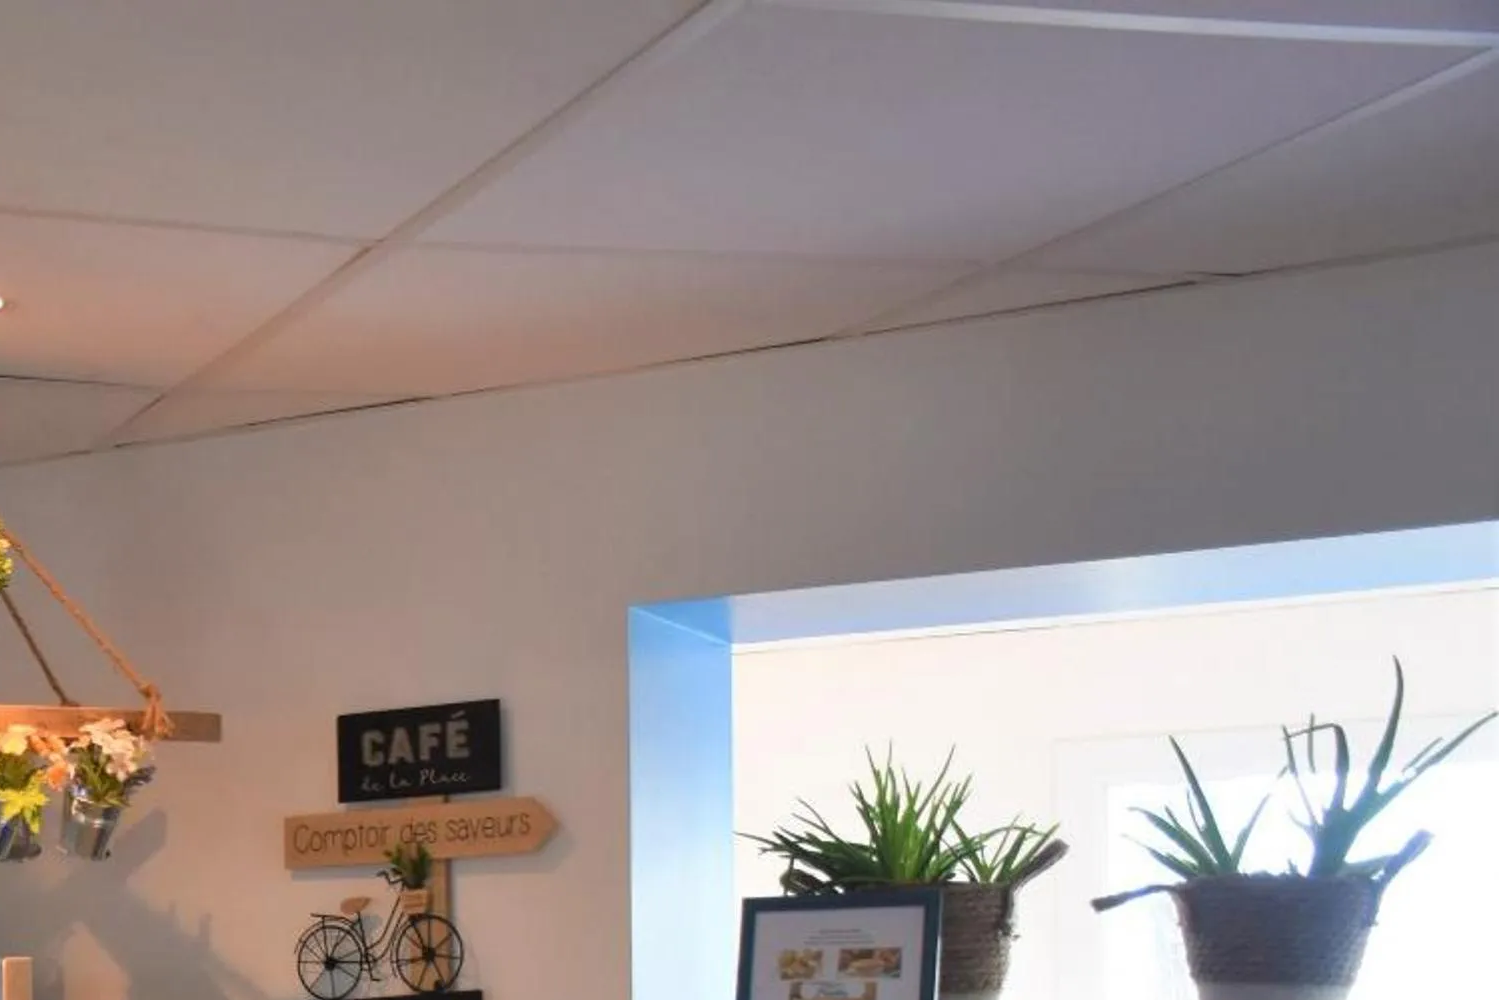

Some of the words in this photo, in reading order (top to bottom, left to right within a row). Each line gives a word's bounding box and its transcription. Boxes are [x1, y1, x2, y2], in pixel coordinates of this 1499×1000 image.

[361, 709, 471, 767] CAFÉ
[292, 821, 390, 857] Comptoir
[400, 814, 439, 845] des
[445, 811, 532, 843] saveurs
